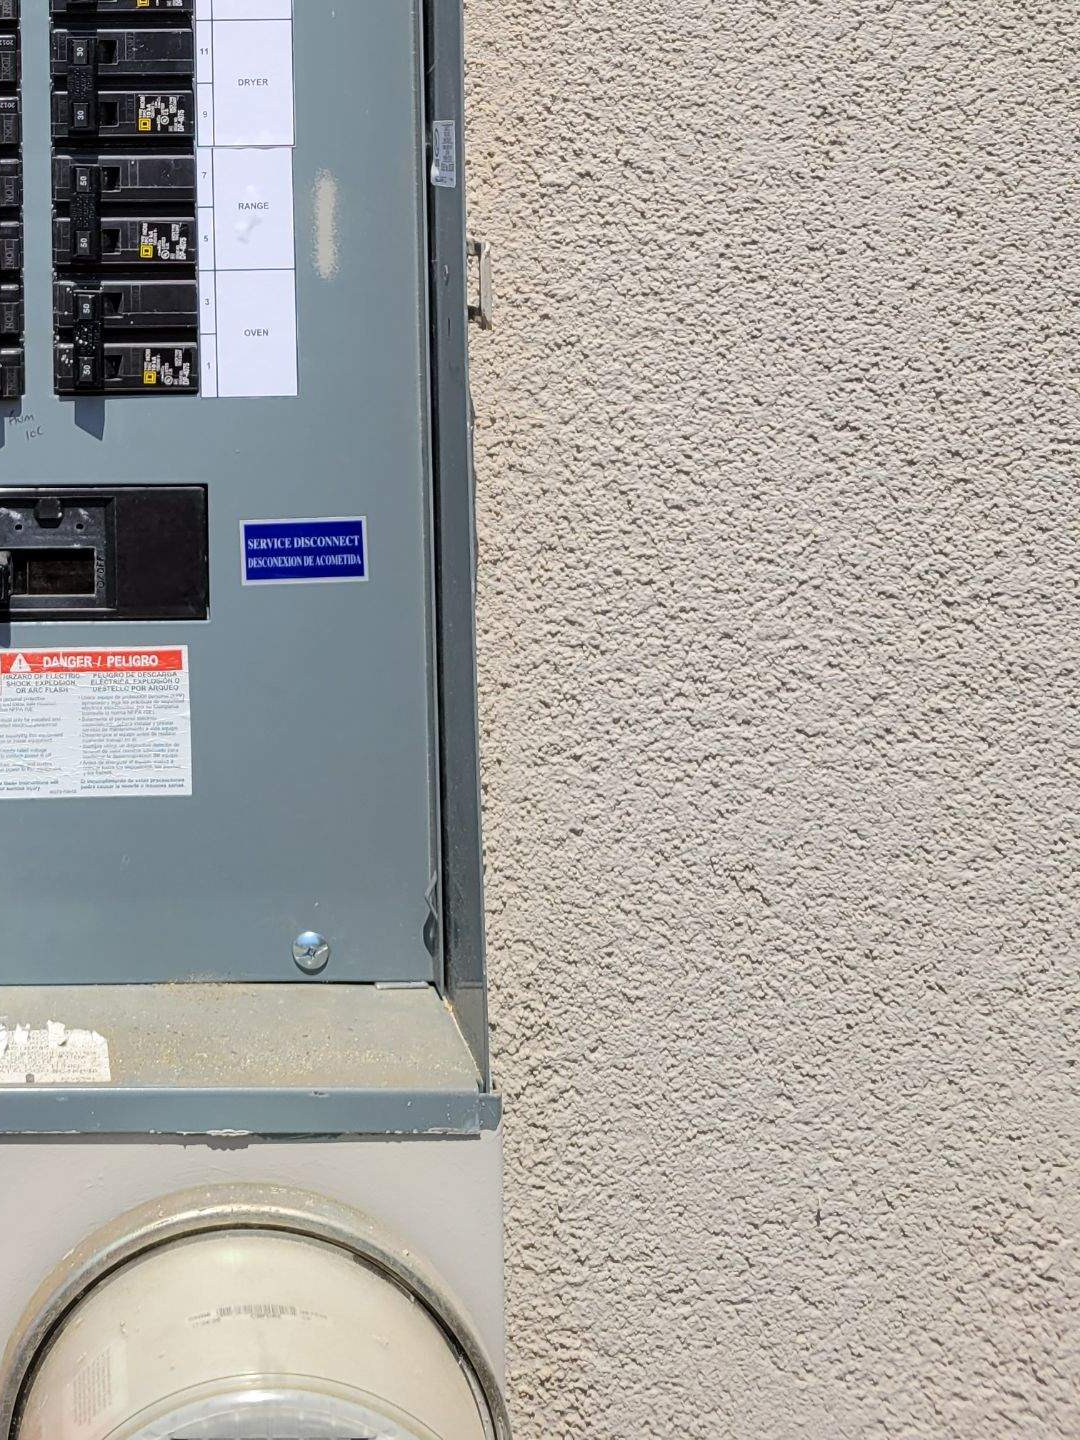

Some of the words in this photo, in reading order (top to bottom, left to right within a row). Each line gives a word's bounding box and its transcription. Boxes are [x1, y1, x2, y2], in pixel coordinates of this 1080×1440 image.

[238, 202, 269, 210] RANGE
[244, 329, 269, 337] OVEN
[248, 538, 291, 549] SERVICE
[294, 535, 359, 547] DISCONNECT
[248, 556, 302, 568] DESCONEXION
[304, 556, 314, 566] DE
[316, 554, 361, 565] ACOMETIDA
[43, 656, 93, 668] DANGER
[107, 655, 158, 667] PELIGRO
